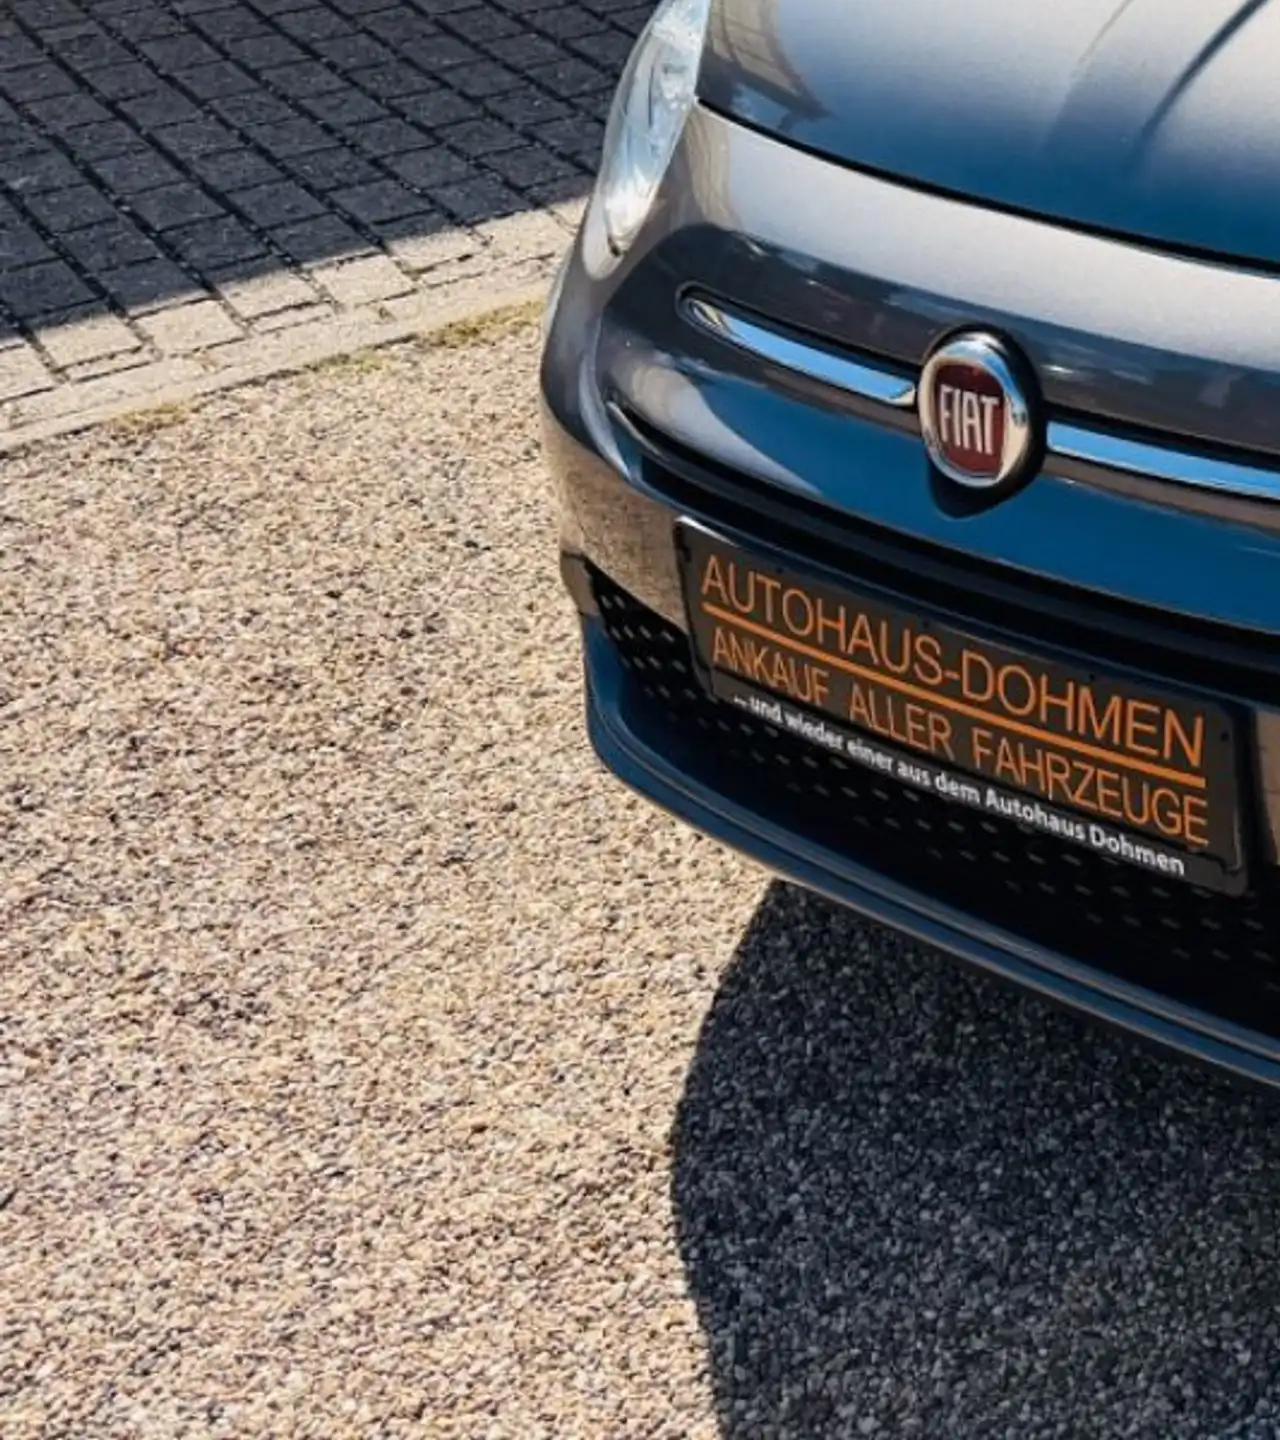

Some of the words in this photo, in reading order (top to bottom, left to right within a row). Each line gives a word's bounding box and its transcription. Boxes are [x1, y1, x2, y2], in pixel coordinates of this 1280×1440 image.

[939, 383, 999, 456] FIAT
[701, 553, 1205, 768] AUTOHAUS-DOHMEN
[713, 626, 831, 707] ANKAUF
[849, 681, 955, 761] ALLER
[973, 728, 1209, 847] FAHRZEUGE
[785, 712, 843, 750] wieder
[847, 737, 894, 773] einer
[897, 760, 931, 787] aus
[934, 772, 981, 805] dem
[985, 788, 1087, 841] Autohaus
[1089, 825, 1186, 876] Dohmen
